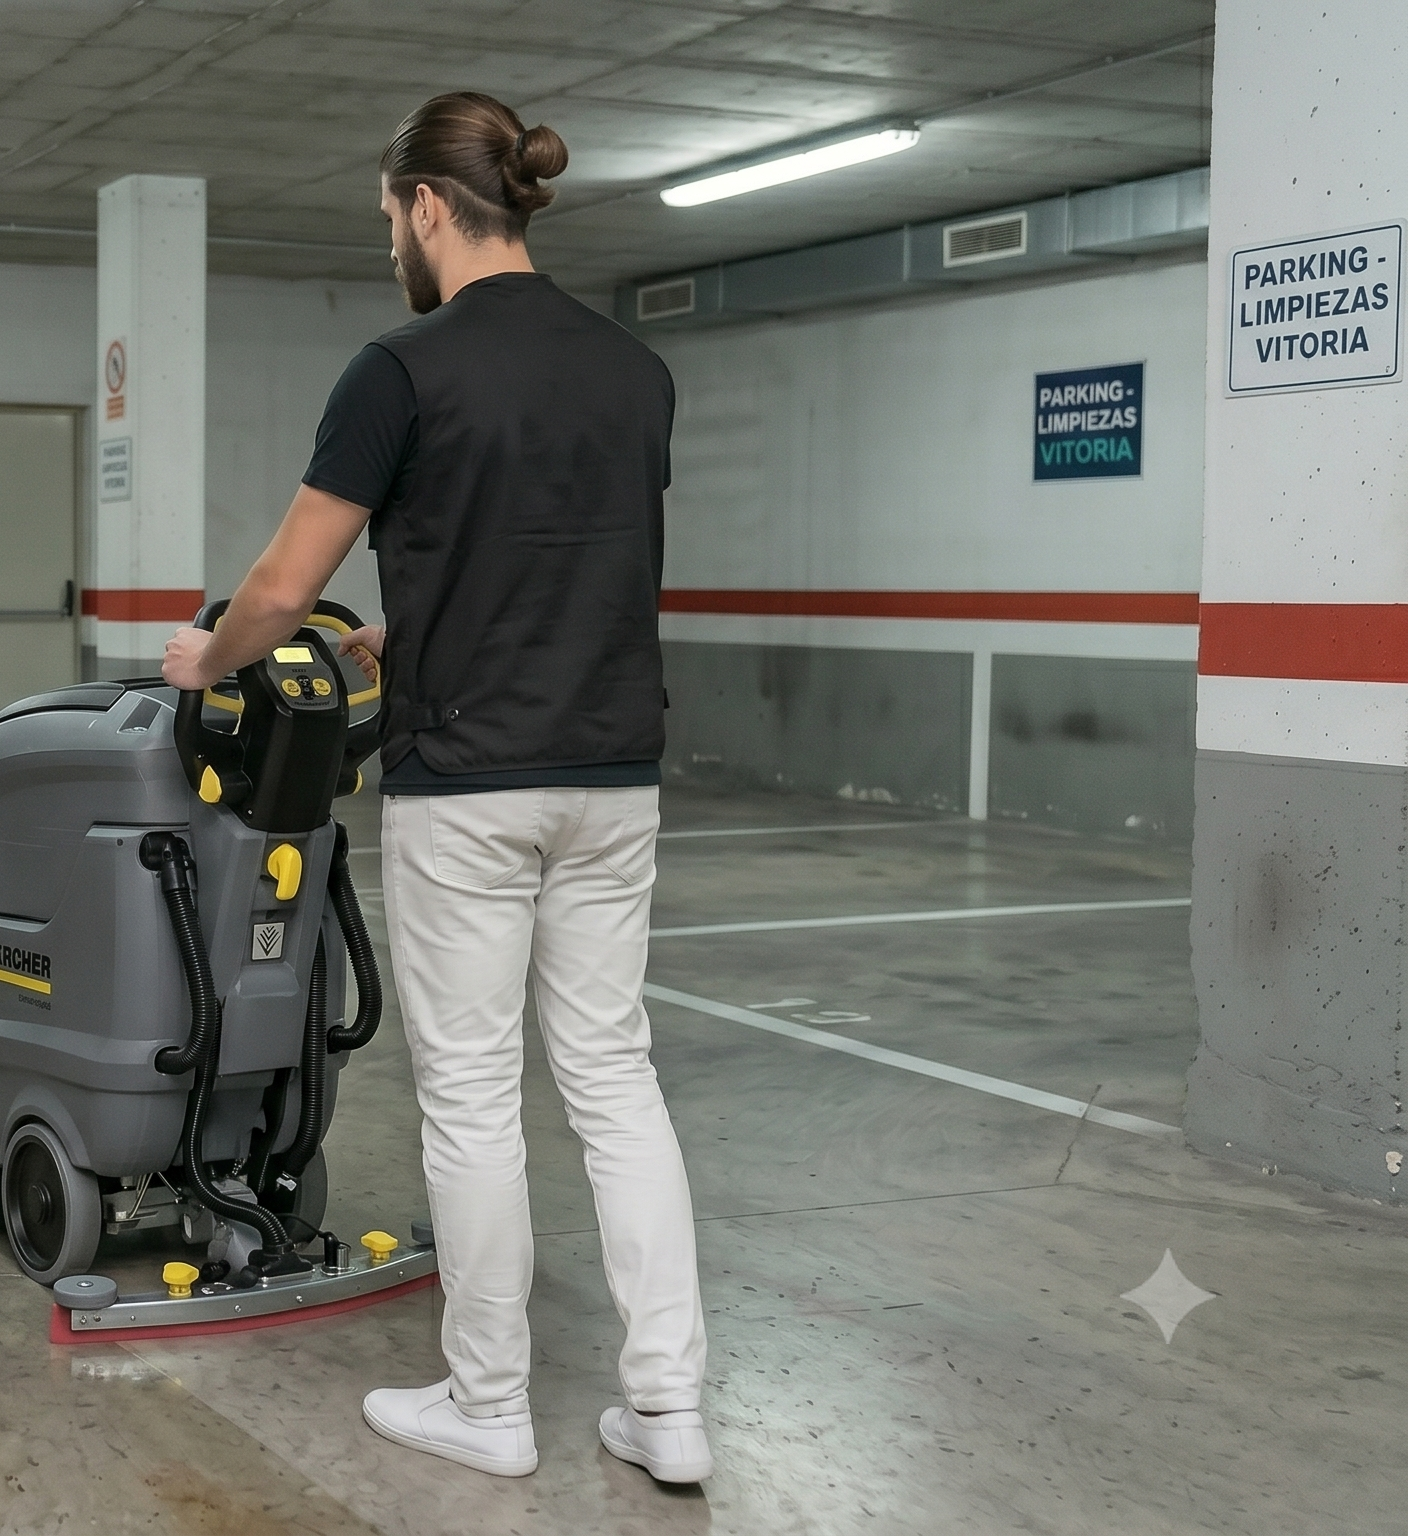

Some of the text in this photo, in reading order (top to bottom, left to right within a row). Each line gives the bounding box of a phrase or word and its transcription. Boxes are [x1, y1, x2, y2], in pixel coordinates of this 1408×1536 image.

[1245, 246, 1368, 290] PARKING
[1240, 282, 1389, 328] LIMPIEZAS
[1255, 326, 1369, 363] VITORIA
[1039, 379, 1124, 409] PARKING
[1037, 406, 1137, 435] LIMPIEZAS
[1039, 436, 1133, 466] VITORIA
